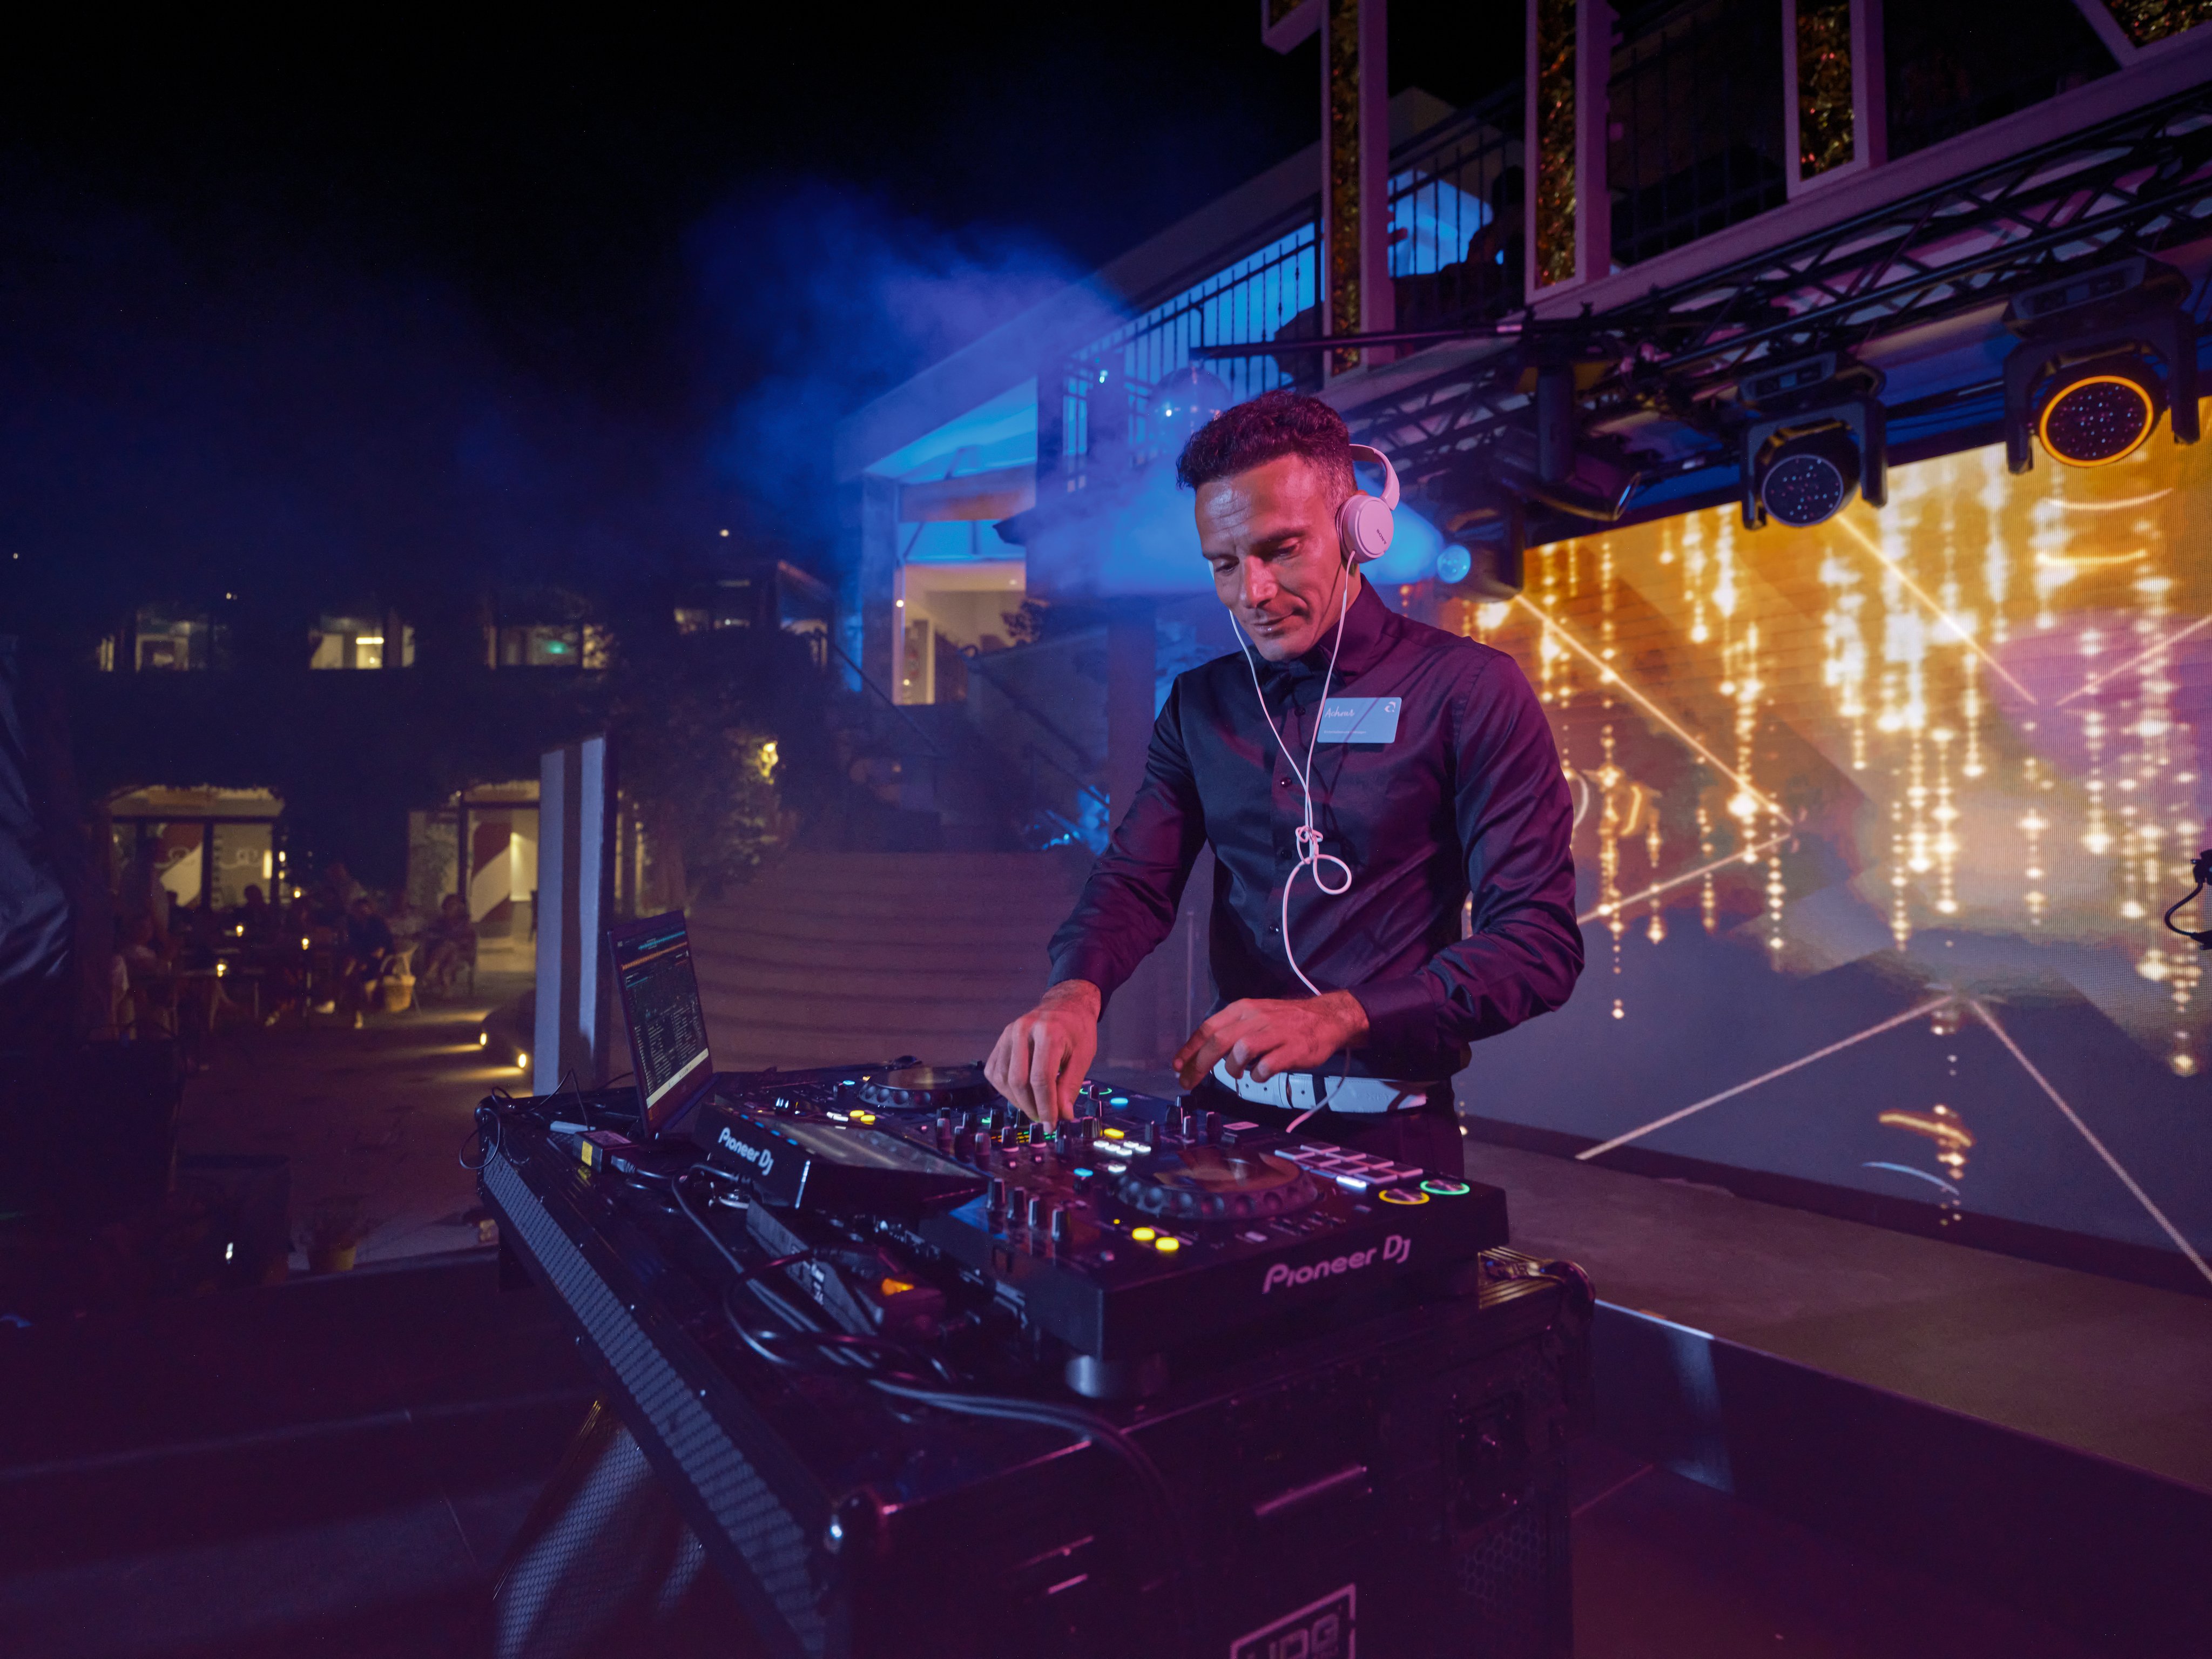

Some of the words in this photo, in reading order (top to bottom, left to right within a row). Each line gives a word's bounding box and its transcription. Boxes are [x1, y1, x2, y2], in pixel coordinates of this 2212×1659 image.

[1376, 529, 1387, 545] SONY
[718, 1127, 760, 1163] Pioneer
[758, 1149, 774, 1176] DJ
[1263, 1246, 1377, 1293] Pioneer
[1382, 1234, 1411, 1264] DJ
